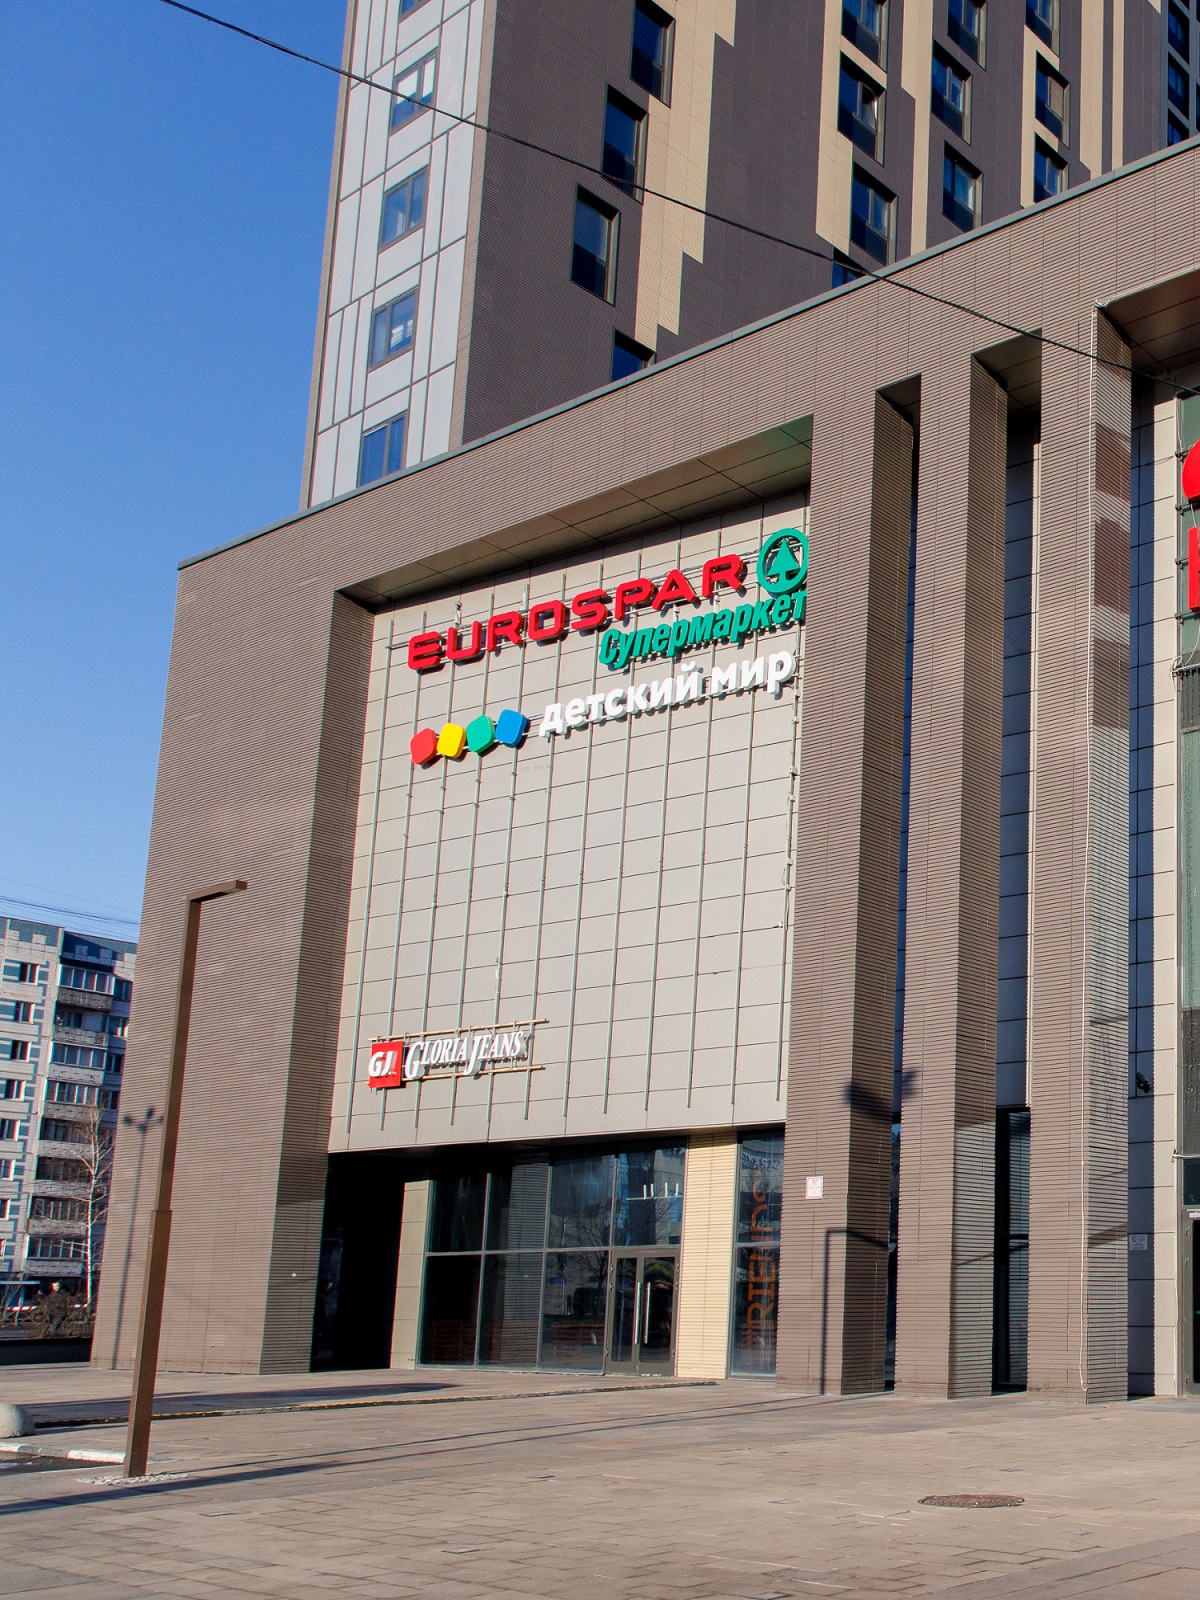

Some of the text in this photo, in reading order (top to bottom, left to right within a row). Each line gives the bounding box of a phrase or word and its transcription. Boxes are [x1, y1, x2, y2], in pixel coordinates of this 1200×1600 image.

[407, 553, 747, 670] EUROSPAR
[599, 590, 808, 668] Супермаркет
[539, 648, 797, 737] детский мир
[404, 1036, 469, 1079] GLORIA
[464, 1030, 528, 1076] JEANS
